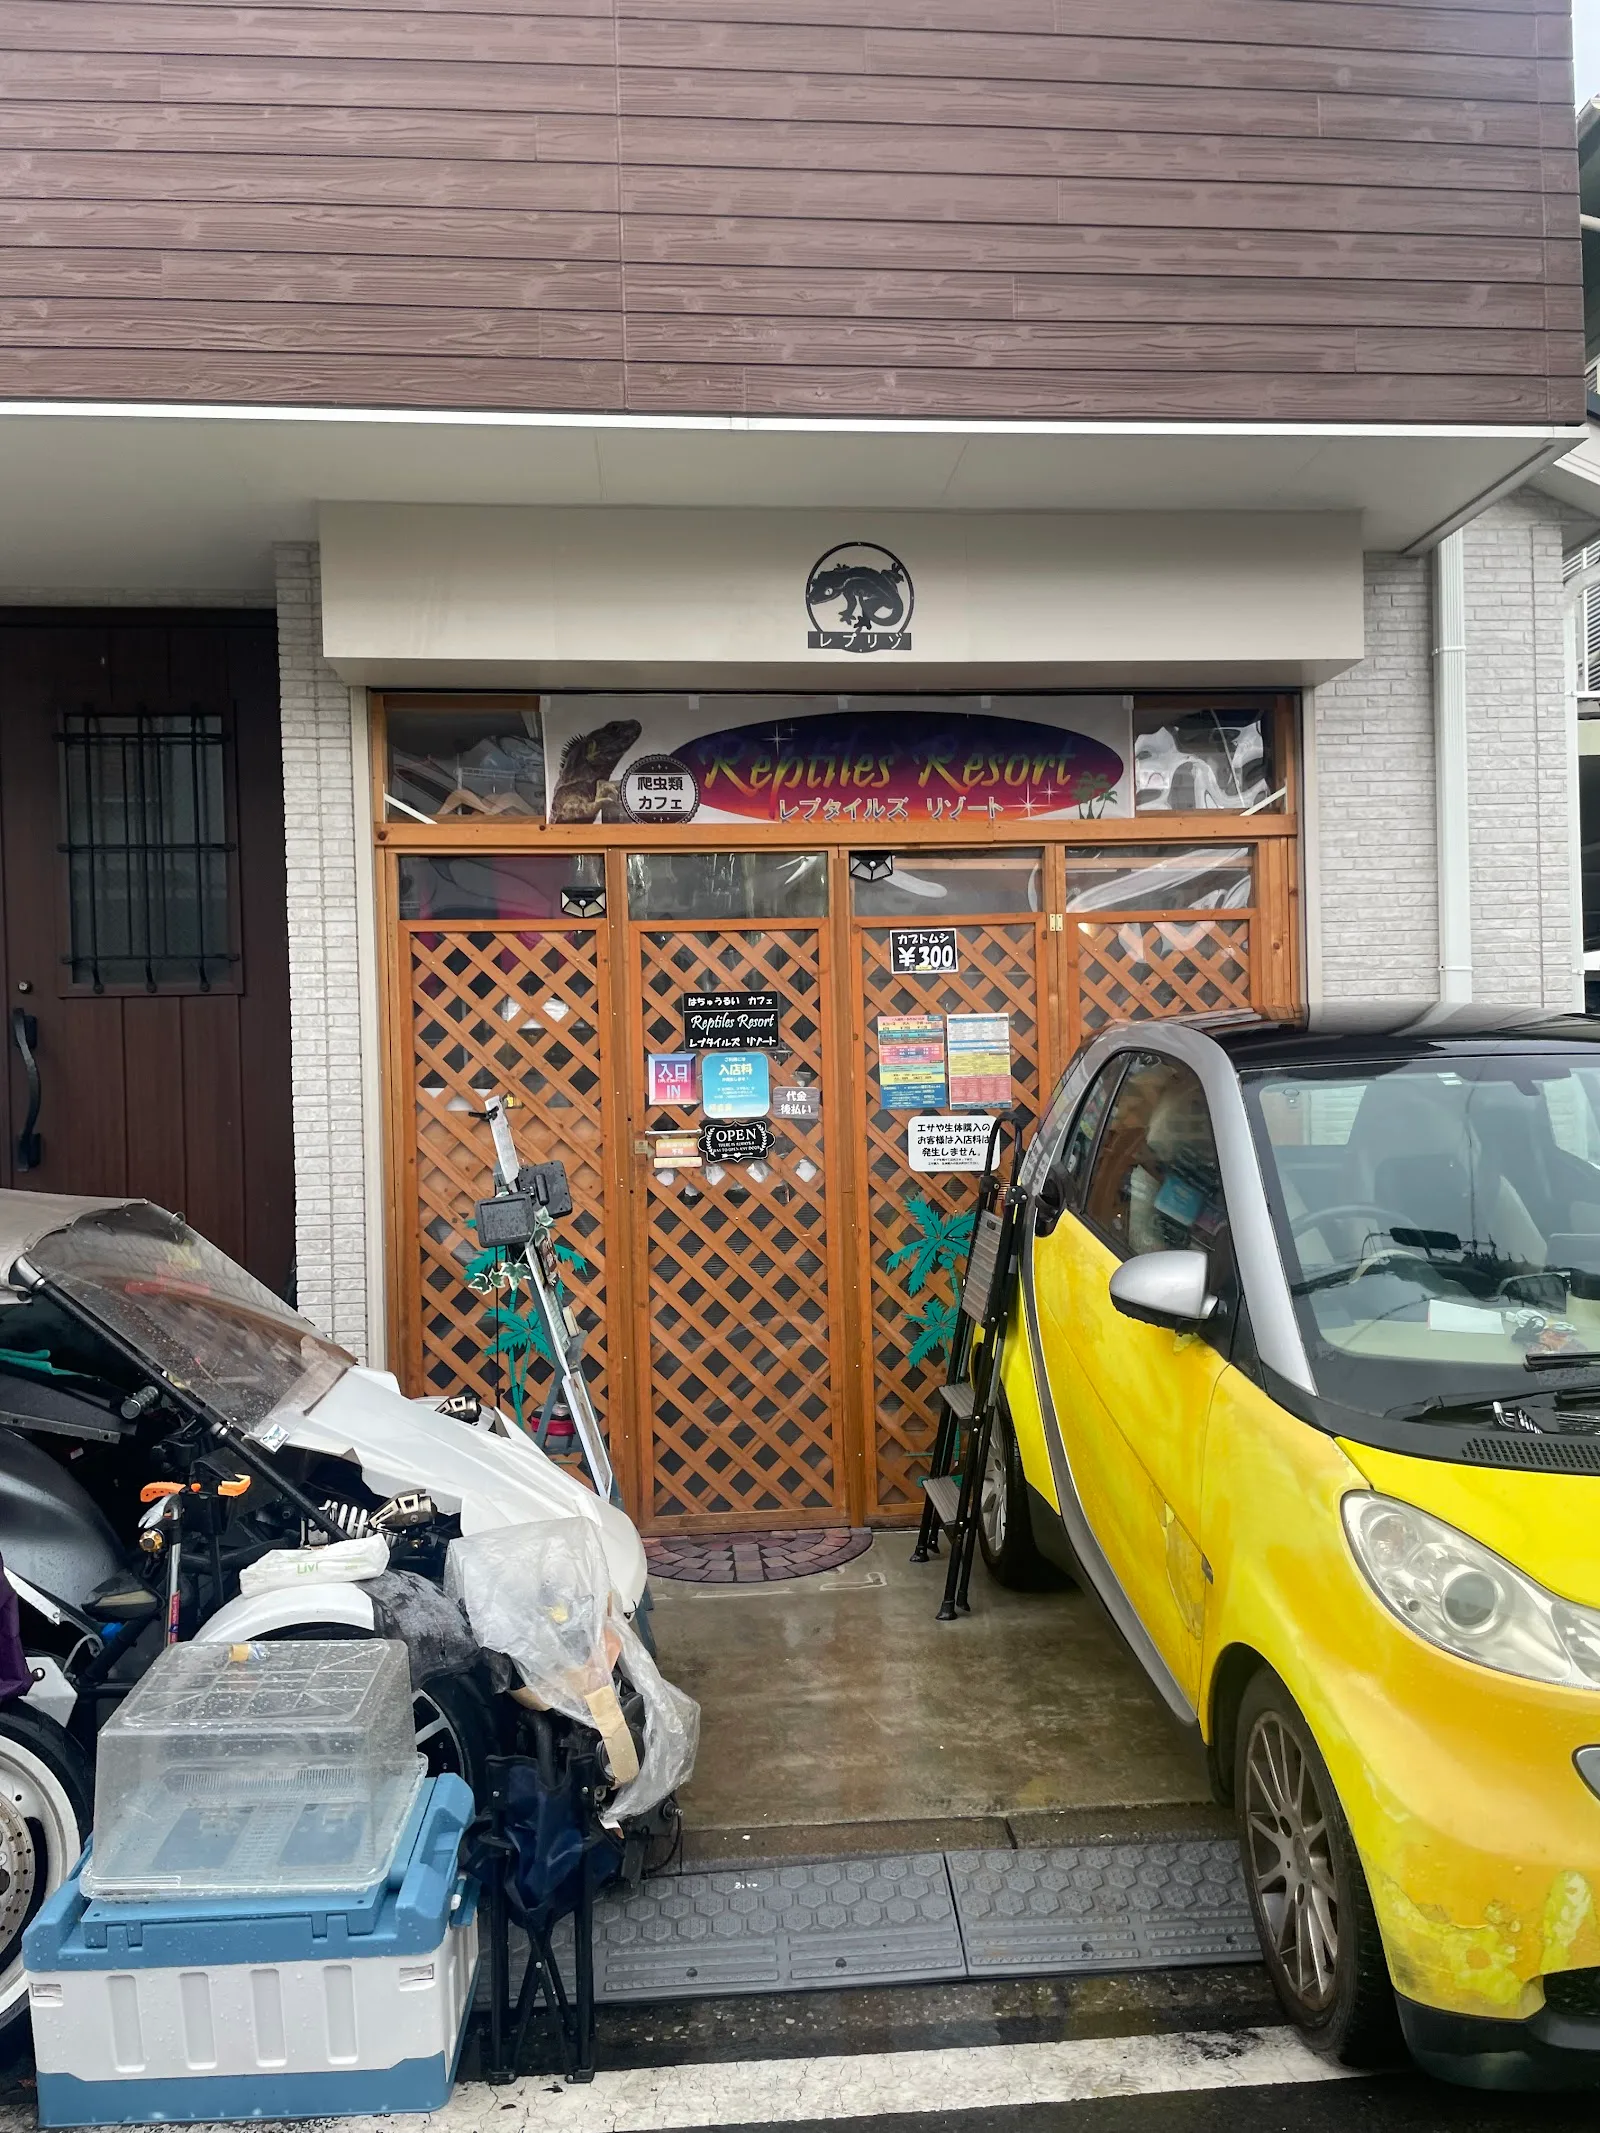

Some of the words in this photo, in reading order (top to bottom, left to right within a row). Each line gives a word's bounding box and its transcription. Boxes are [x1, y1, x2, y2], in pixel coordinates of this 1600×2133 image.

[820, 632, 903, 650] レプリゾ
[697, 725, 903, 820] Reptiles
[912, 732, 1077, 795] Resort
[637, 776, 684, 791] 爬虫類
[639, 796, 683, 810] カフェ
[779, 796, 910, 820] レプタイルズ
[926, 796, 1004, 819] リゾート
[897, 933, 949, 944] カブトムシ
[897, 945, 953, 967] ¥300
[688, 996, 740, 1007] はちゅうるい
[747, 996, 773, 1005] カフェ
[690, 1012, 735, 1035] Reptiles
[737, 1013, 775, 1029] Resort
[658, 1063, 687, 1079] 入口
[718, 1063, 753, 1075] 入店料
[666, 1085, 680, 1099] IN
[786, 1090, 807, 1101] 代金
[780, 1103, 812, 1115] 後払い
[716, 1128, 757, 1142] OPEN
[917, 1123, 990, 1133] エサや生体購入の
[917, 1135, 991, 1145] お客様は入店料は
[922, 1147, 981, 1157] 発生しません。
